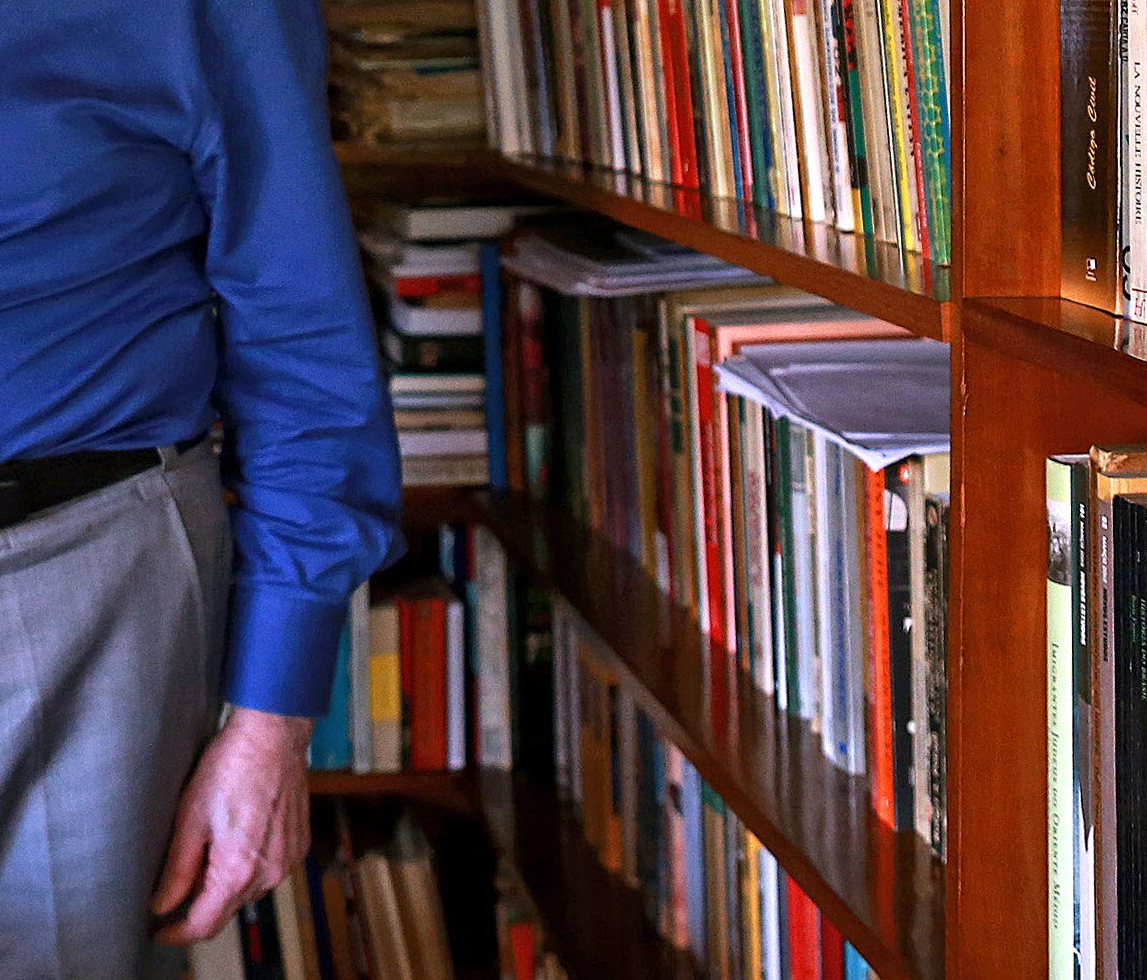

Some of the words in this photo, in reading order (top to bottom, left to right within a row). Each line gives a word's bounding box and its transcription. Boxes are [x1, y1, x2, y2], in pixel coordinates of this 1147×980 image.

[1133, 62, 1141, 79] LA
[1134, 85, 1142, 158] NOUVELLE
[1134, 163, 1142, 224] HISTOIRE
